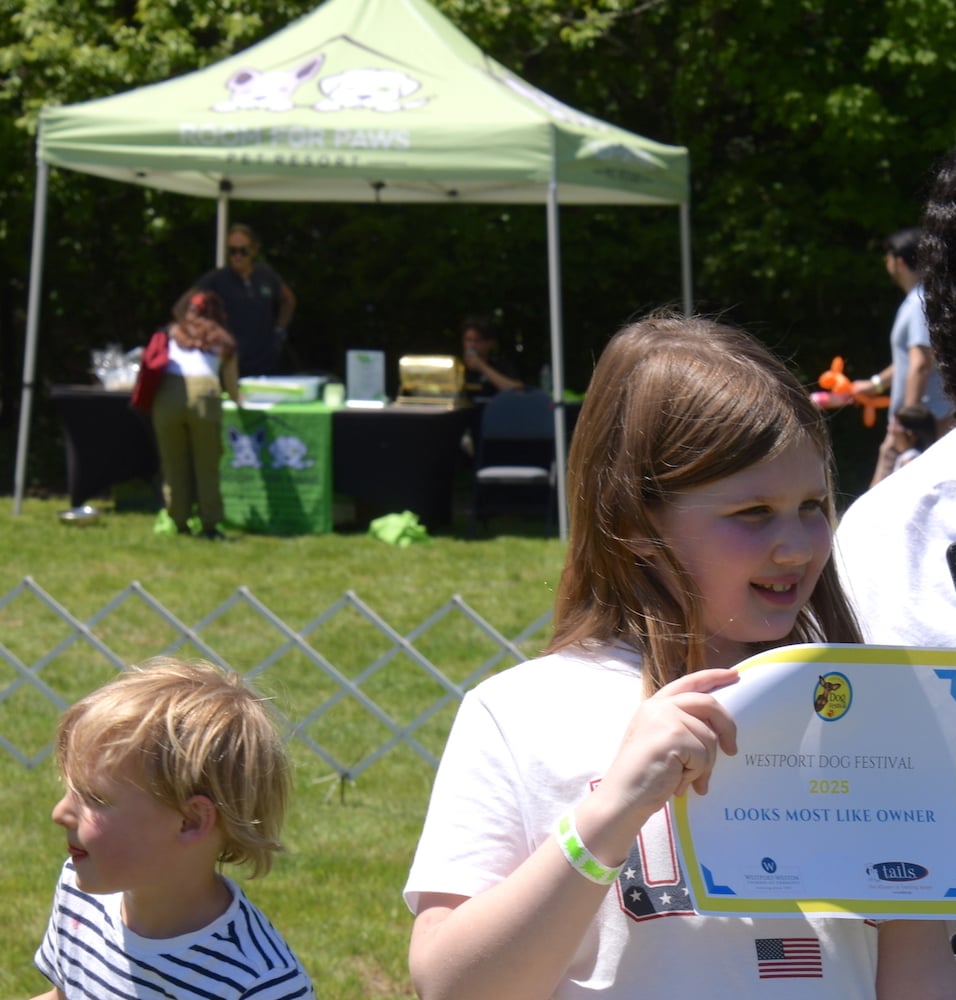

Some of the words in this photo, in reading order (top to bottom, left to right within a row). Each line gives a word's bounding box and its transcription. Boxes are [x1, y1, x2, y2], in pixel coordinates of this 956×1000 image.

[179, 124, 262, 146] ROOM
[270, 126, 325, 148] FOR
[334, 128, 411, 150] PAWS
[226, 153, 264, 166] PET
[274, 154, 359, 168] RESORT
[745, 753, 815, 768] WESTPORT
[818, 754, 851, 769] DOG
[854, 755, 915, 770] FESTIVAL
[808, 779, 850, 795] 2025
[724, 807, 781, 821] LOOKS
[785, 808, 831, 822] MOST
[836, 809, 872, 822] LIKE
[876, 809, 936, 823] OWNER
[882, 862, 918, 880] tails
